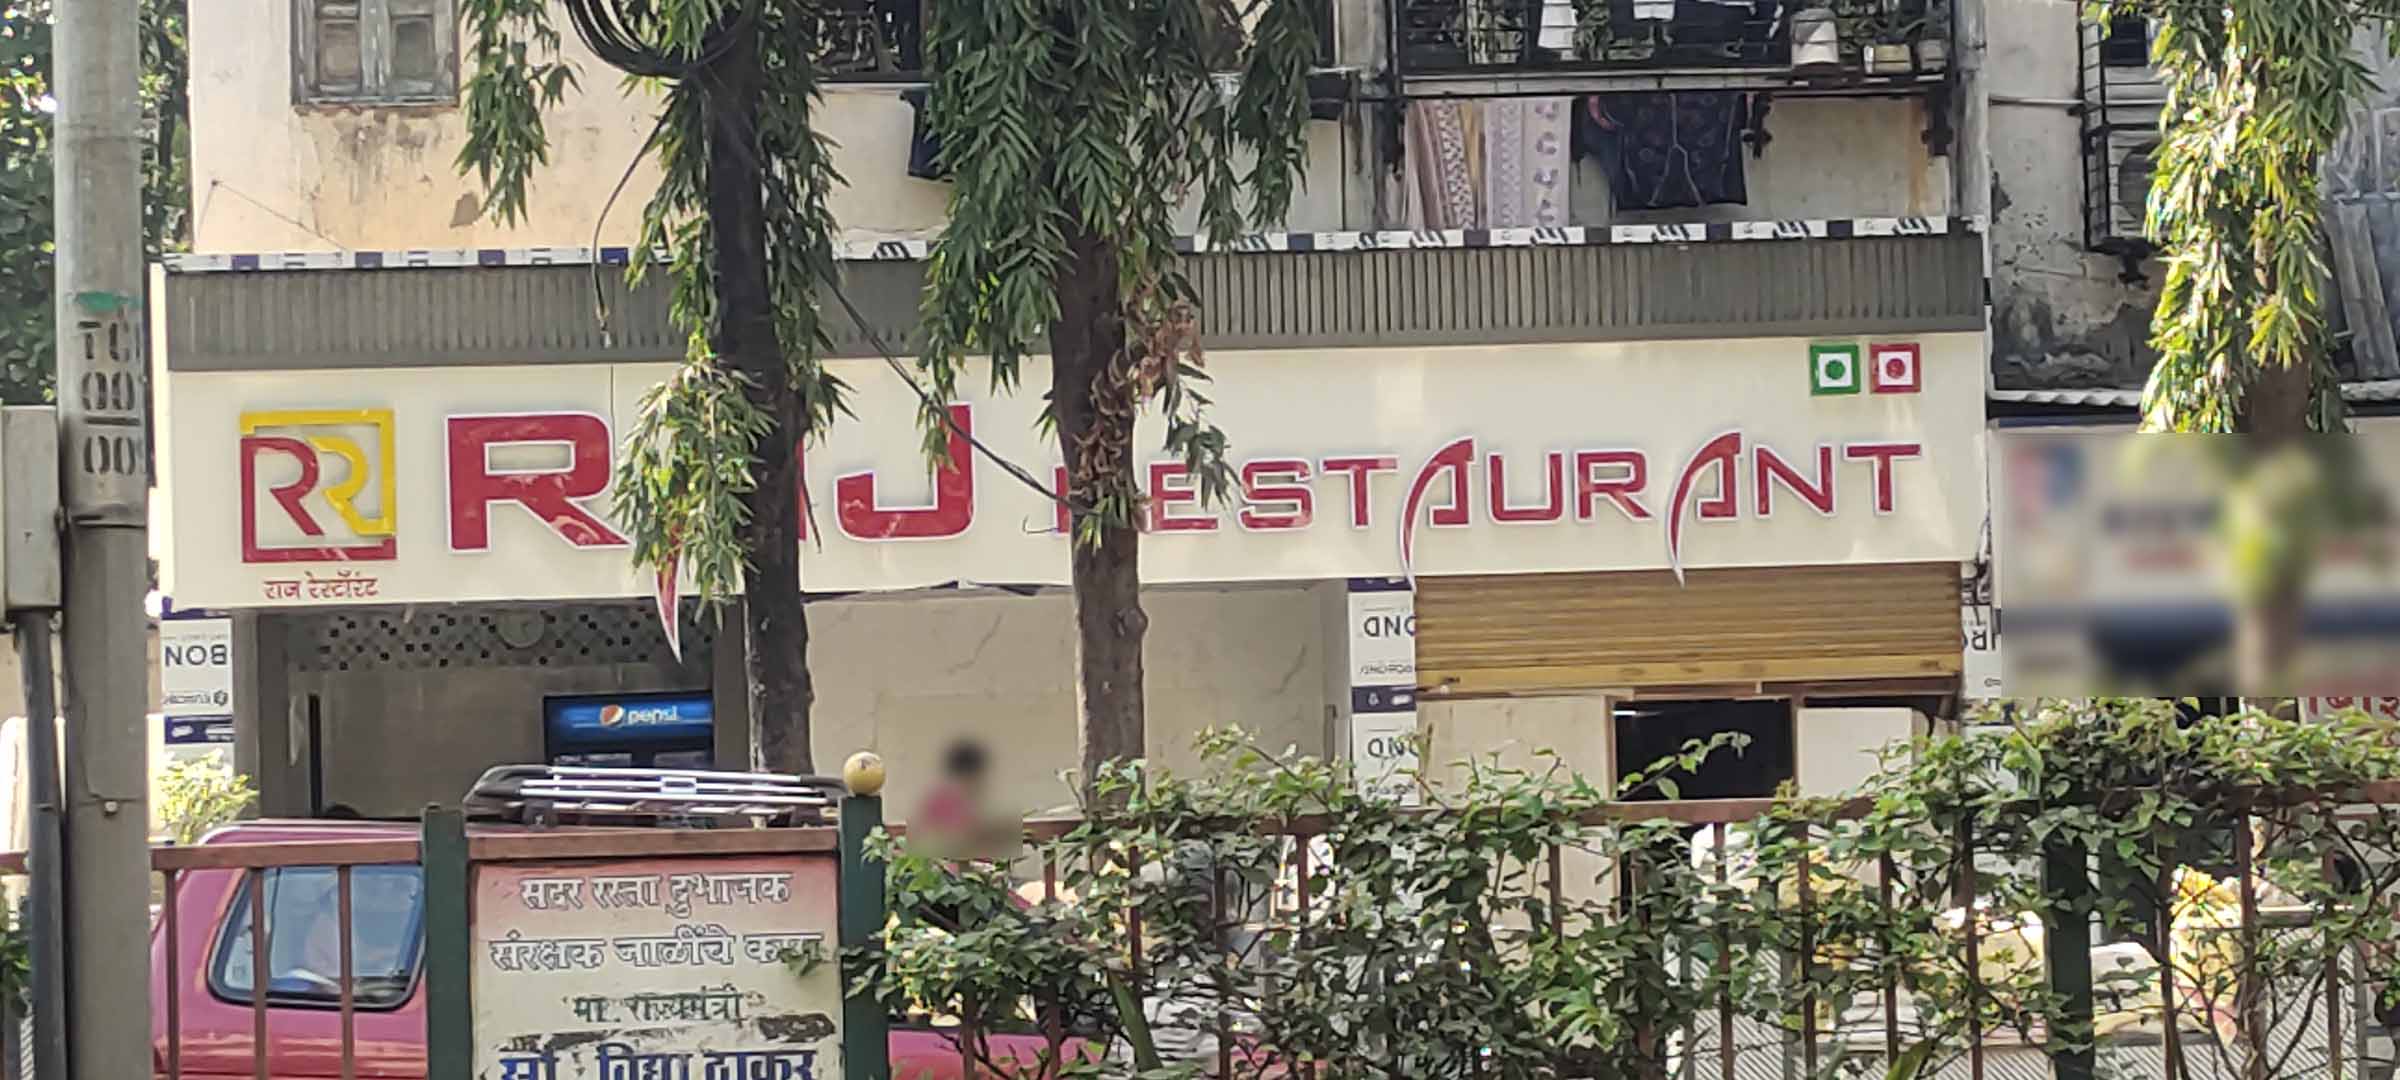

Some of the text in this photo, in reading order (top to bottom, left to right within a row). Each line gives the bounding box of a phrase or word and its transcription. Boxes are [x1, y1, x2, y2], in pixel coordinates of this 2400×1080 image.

[445, 402, 1923, 664] RJ ESTAURANT
[264, 579, 300, 599] राज
[627, 705, 678, 725] pepsi
[520, 872, 794, 918] सदर रस्ता दुभाजक
[488, 928, 606, 971] संरक्षक
